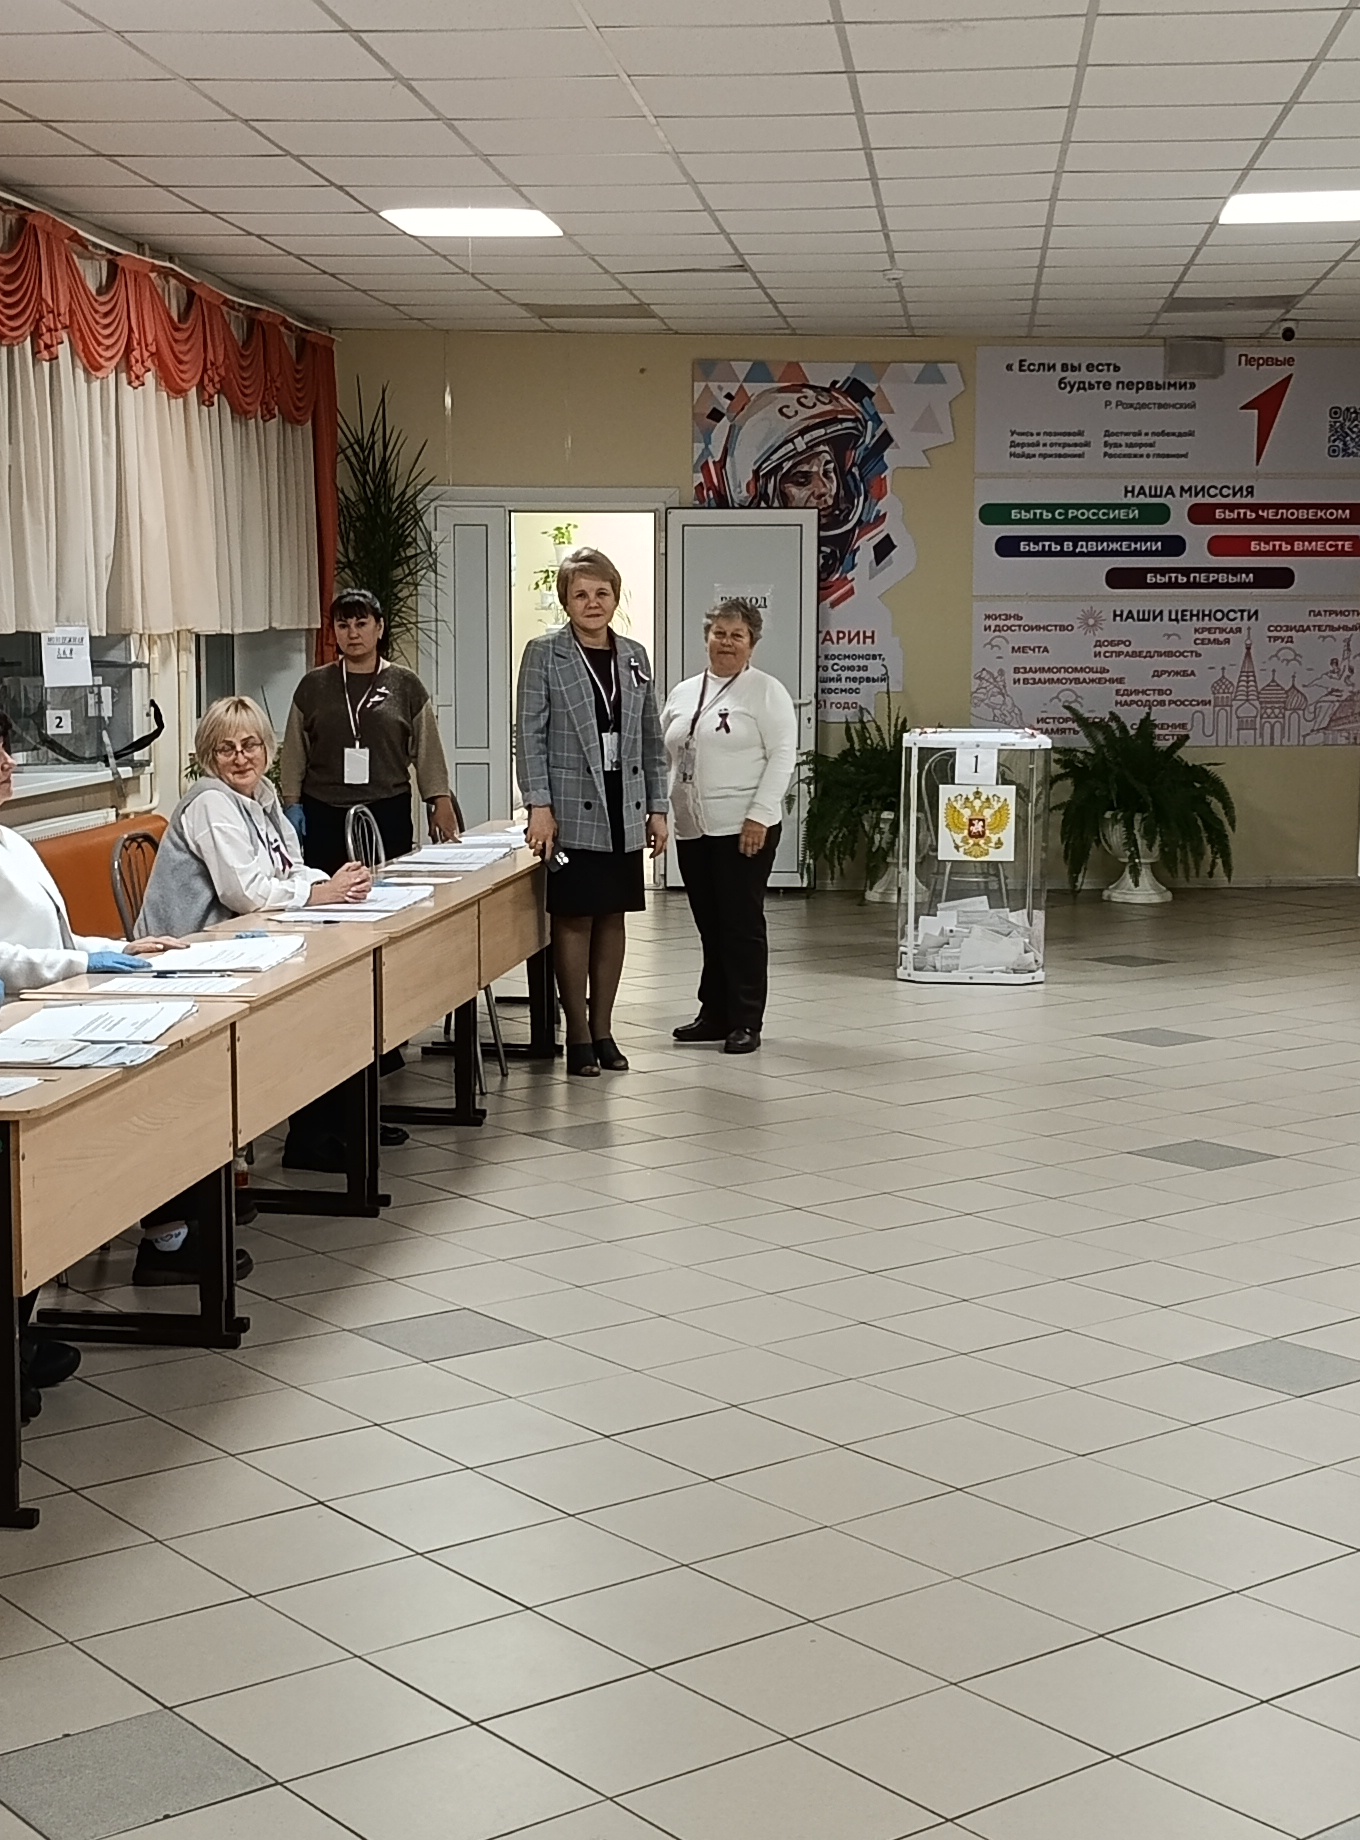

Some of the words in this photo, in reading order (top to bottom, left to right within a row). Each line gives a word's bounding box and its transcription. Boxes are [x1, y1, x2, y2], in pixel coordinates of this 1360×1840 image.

[1018, 359, 1056, 372] Если
[1060, 363, 1081, 372] вы
[1086, 362, 1120, 372] есть
[1238, 354, 1295, 370] Первые
[1058, 377, 1112, 394] будьте
[1116, 380, 1196, 393] первыми»
[1116, 400, 1196, 410] Рождественский
[1124, 486, 1175, 498] НАША
[1180, 485, 1254, 498] МИССИЯ
[1011, 509, 1052, 520] БЫТЬ
[1056, 509, 1064, 520] С
[1068, 507, 1139, 520] РОССИЕЙ
[1215, 509, 1256, 520] БЫТЬ
[1260, 509, 1350, 520] ЧЕЛОВЕКОМ
[1020, 541, 1060, 552] БЫТЬ
[1064, 541, 1072, 552] В
[1076, 541, 1162, 553] ДВИЖЕНИИ
[1251, 541, 1291, 552] БЫТЬ
[1294, 541, 1353, 552] ВМЕСТЕ
[1147, 573, 1187, 584] БЫТЬ
[1190, 573, 1254, 584] ПЕРВЫМ
[1113, 609, 1164, 622] НАШИ
[1169, 608, 1259, 624] ЦЕННОСТИ
[984, 624, 991, 632] И
[993, 624, 1074, 632] ДОСТОИНСТВО
[1094, 640, 1131, 648] ДОБРО
[1194, 638, 1230, 646] СЕМЬЯ
[1267, 636, 1294, 644] ТРУД
[1012, 646, 1049, 654] МЕЧТА
[1103, 650, 1202, 659] СПРАВЕДЛИВОСТЬ
[824, 654, 885, 662] космонавт,
[831, 663, 868, 672] Союза
[1152, 670, 1196, 678] ДРУЖБА
[845, 674, 886, 685] первый
[1023, 677, 1126, 685] ВЗАИМОУВАЖЕНИЕ
[1116, 688, 1172, 696] ЕДИНСТВО
[830, 702, 858, 710] года
[1115, 700, 1166, 708] НАРОДОВ
[1171, 700, 1212, 708] РОССИИ
[55, 716, 64, 728] 2
[972, 754, 980, 773] 1
